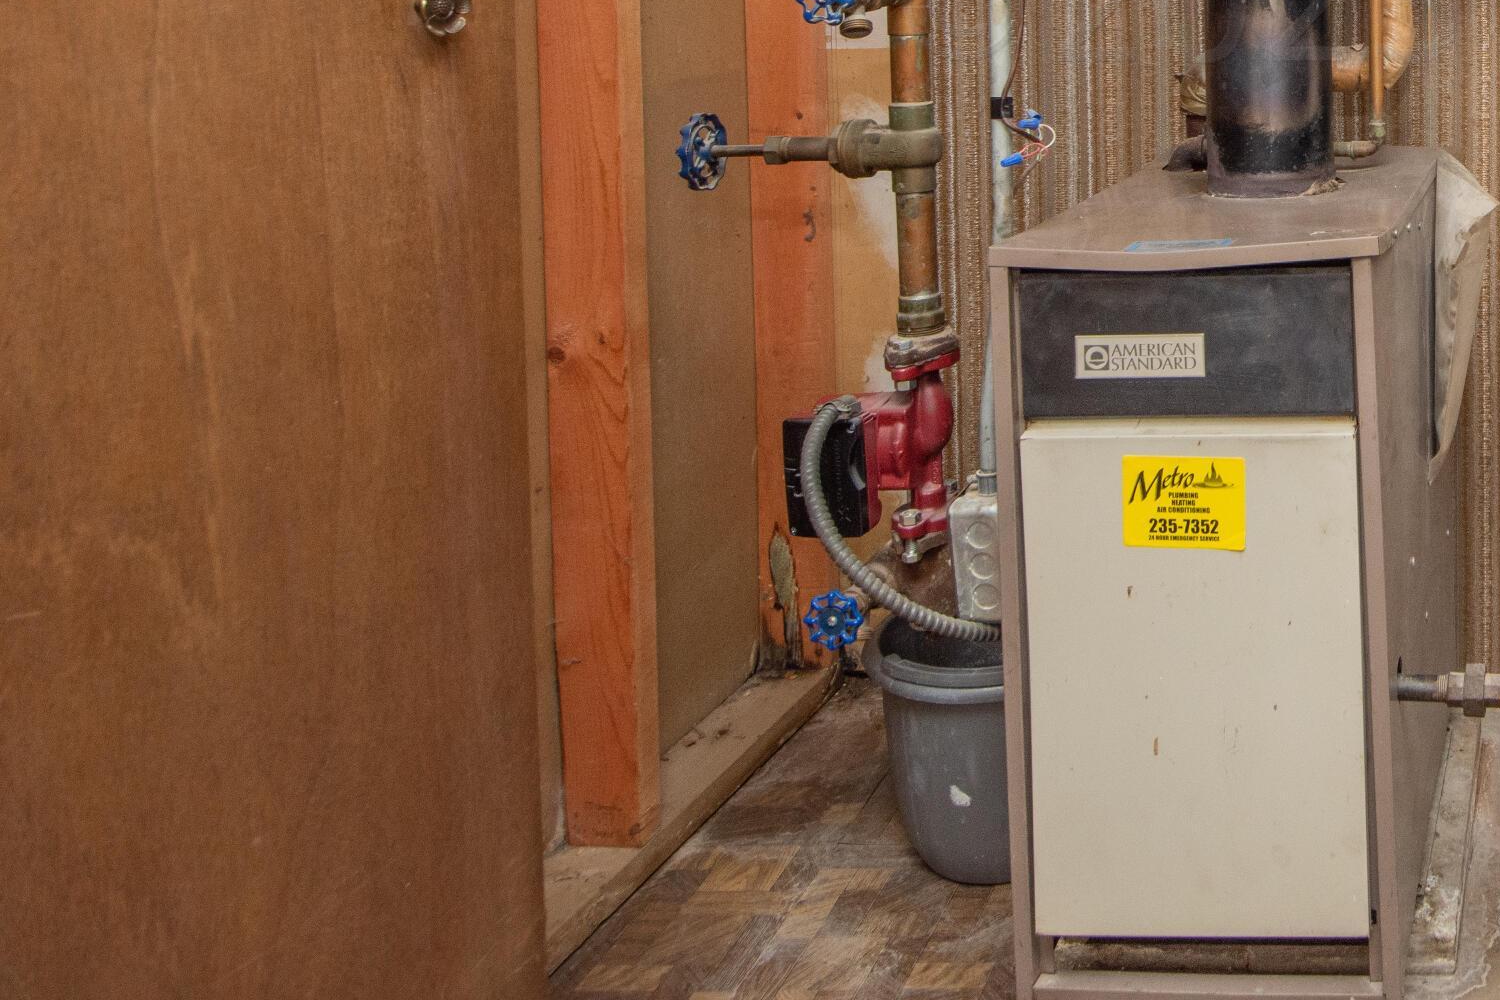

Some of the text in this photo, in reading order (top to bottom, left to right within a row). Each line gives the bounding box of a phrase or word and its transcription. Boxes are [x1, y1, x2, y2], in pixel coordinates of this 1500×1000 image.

[1111, 342, 1196, 357] AMERICAN
[1111, 356, 1197, 371] STANDARD
[1128, 465, 1195, 505] Metro
[1168, 491, 1199, 499] PLUMBING
[1168, 506, 1211, 514] CONDITIONING
[1149, 517, 1219, 535] 235-7352
